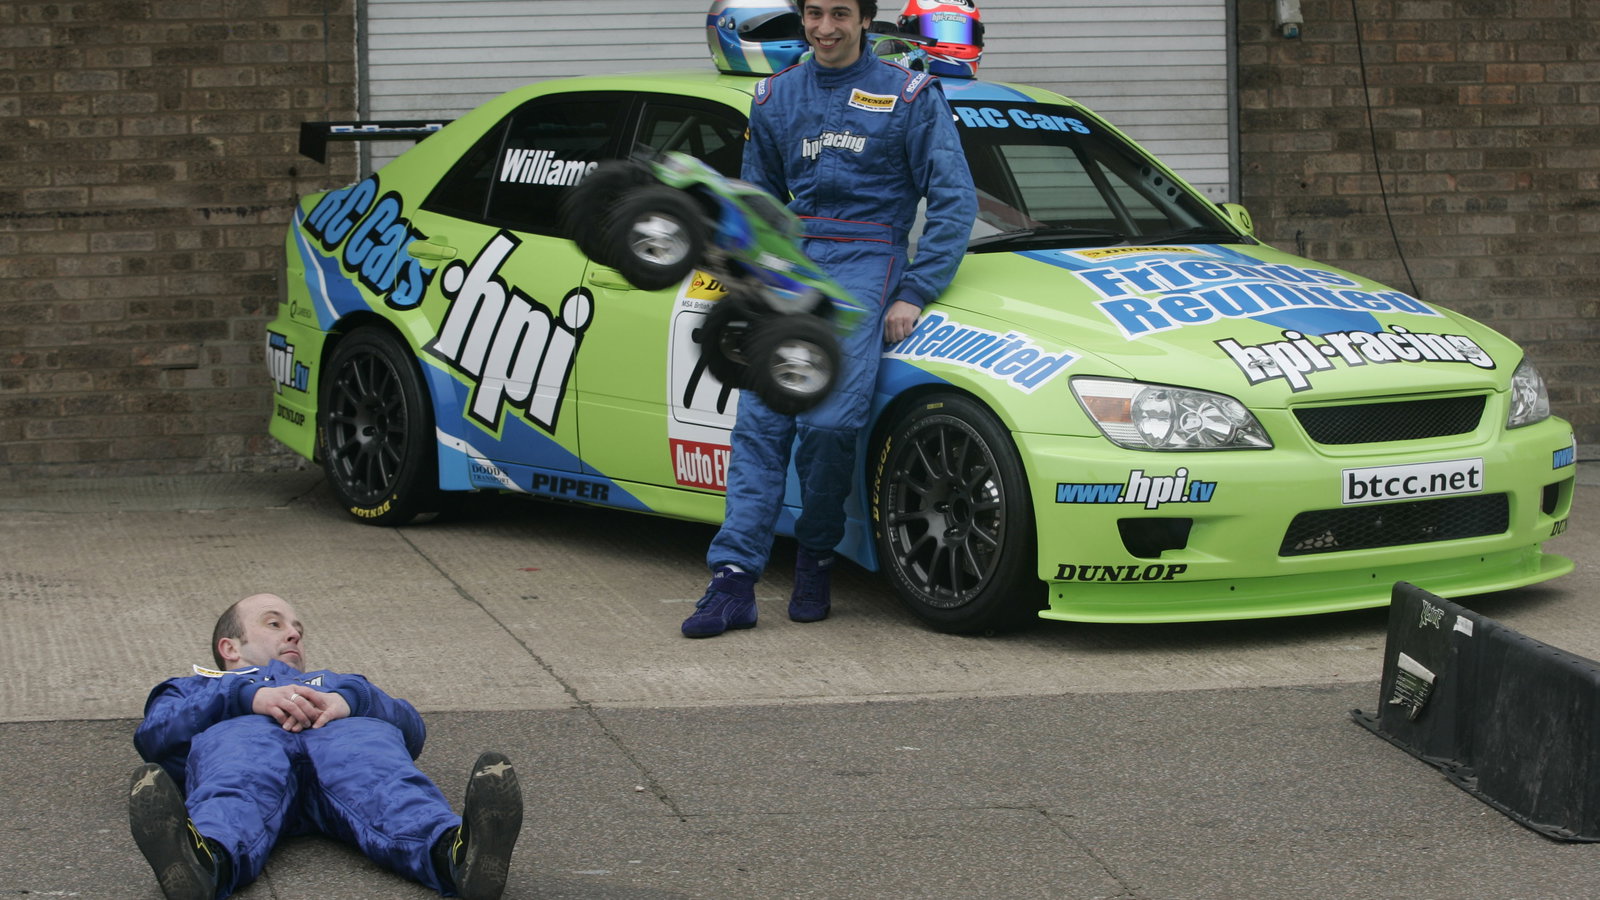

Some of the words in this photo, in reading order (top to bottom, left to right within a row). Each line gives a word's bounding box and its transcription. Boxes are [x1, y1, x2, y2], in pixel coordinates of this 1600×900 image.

[954, 106, 1010, 129] RC
[1007, 109, 1091, 135] Cars
[305, 175, 378, 248] RC
[344, 193, 434, 309] Cars
[1075, 260, 1358, 297] Friends
[1098, 282, 1437, 336] Reunited
[896, 313, 1077, 390] Reunited
[676, 444, 713, 485] Auto
[1348, 466, 1480, 500] btcc.net
[532, 473, 610, 501] PIPER
[1056, 467, 1217, 509] www.hpi.tv
[1054, 563, 1188, 582] DUNLOP
